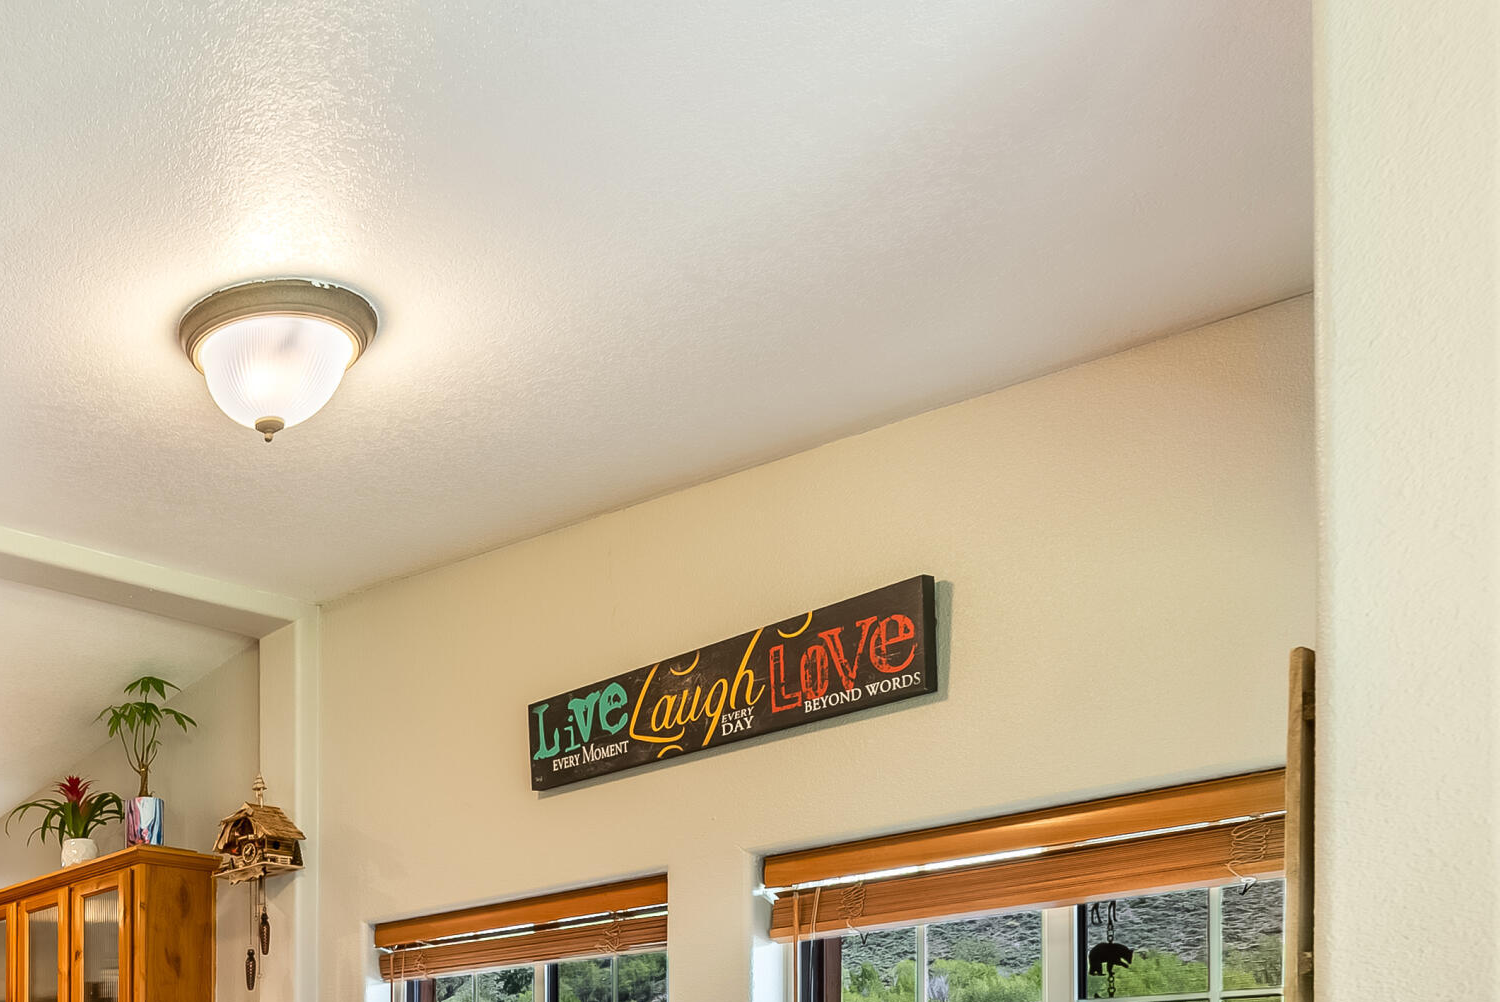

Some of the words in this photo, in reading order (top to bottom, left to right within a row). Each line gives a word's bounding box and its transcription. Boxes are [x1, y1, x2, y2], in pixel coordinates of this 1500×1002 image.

[629, 627, 767, 746] Laugh
[804, 688, 862, 713] BEYOND
[865, 671, 921, 697] WORDS
[721, 706, 754, 723] EVERY
[721, 715, 754, 736] DAY
[552, 754, 580, 772] EVERY
